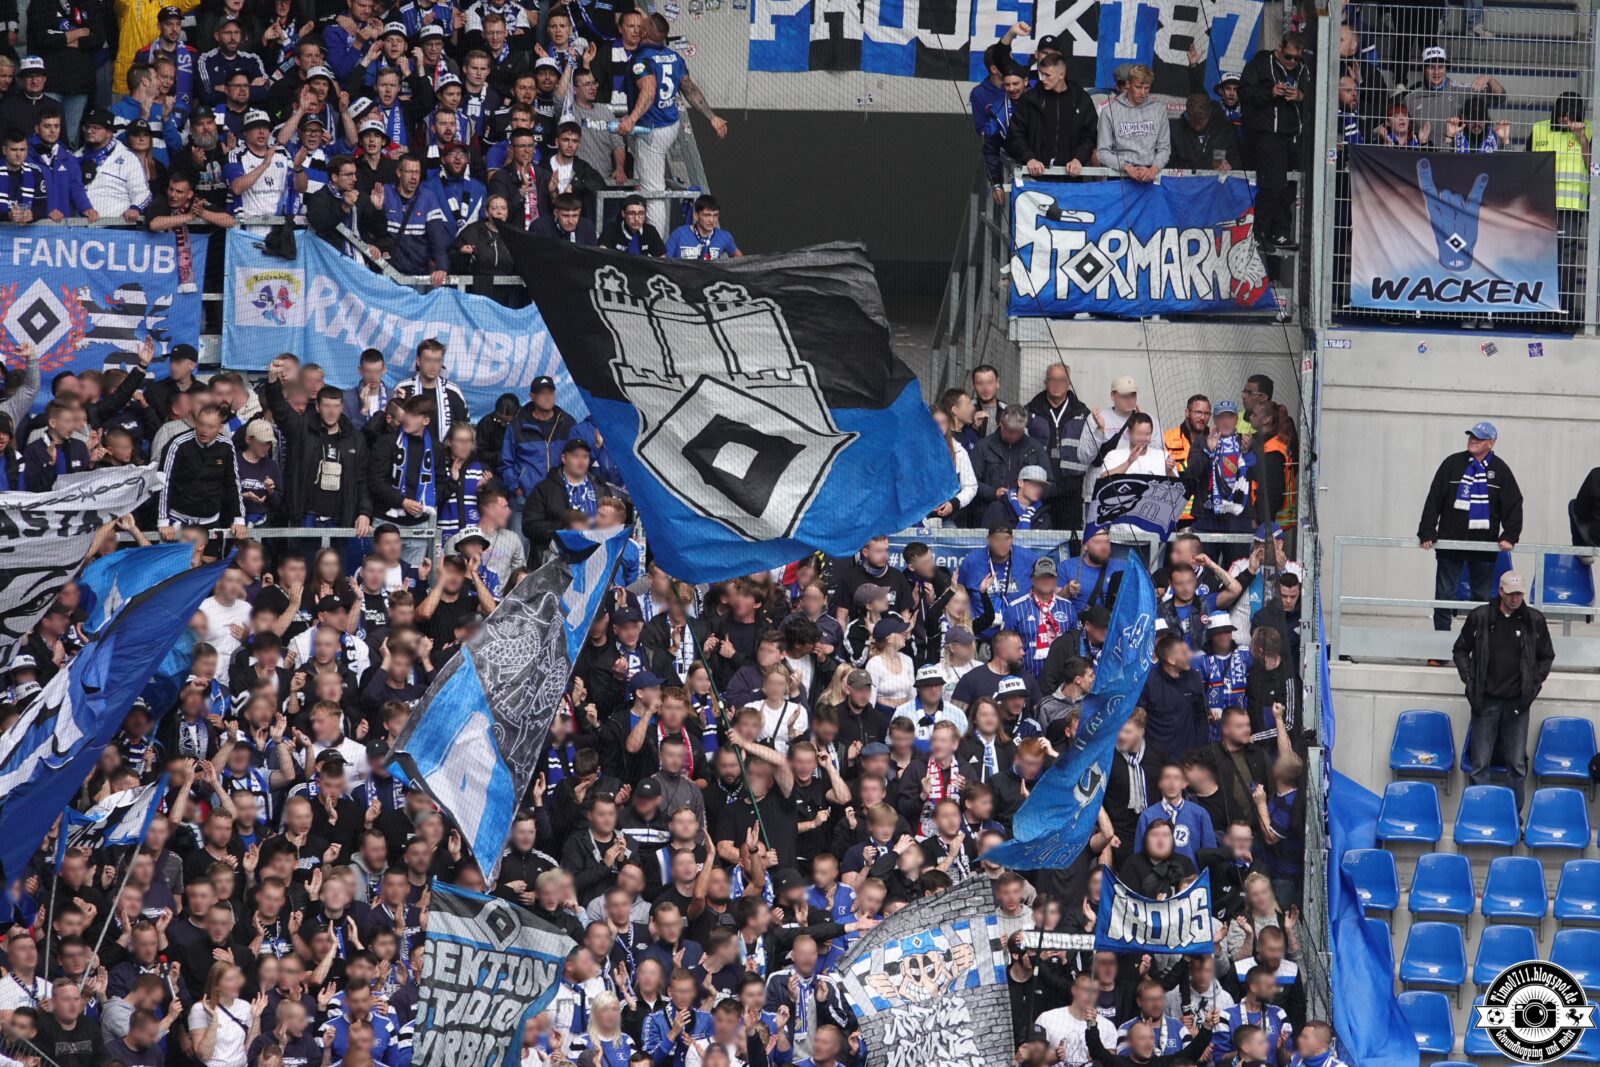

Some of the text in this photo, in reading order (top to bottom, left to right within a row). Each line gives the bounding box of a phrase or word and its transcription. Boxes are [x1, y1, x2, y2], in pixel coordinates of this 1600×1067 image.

[659, 64, 675, 100] 5
[12, 237, 176, 274] FANCLUB
[1371, 276, 1544, 304] WACKEN
[420, 939, 557, 998] SEKTION
